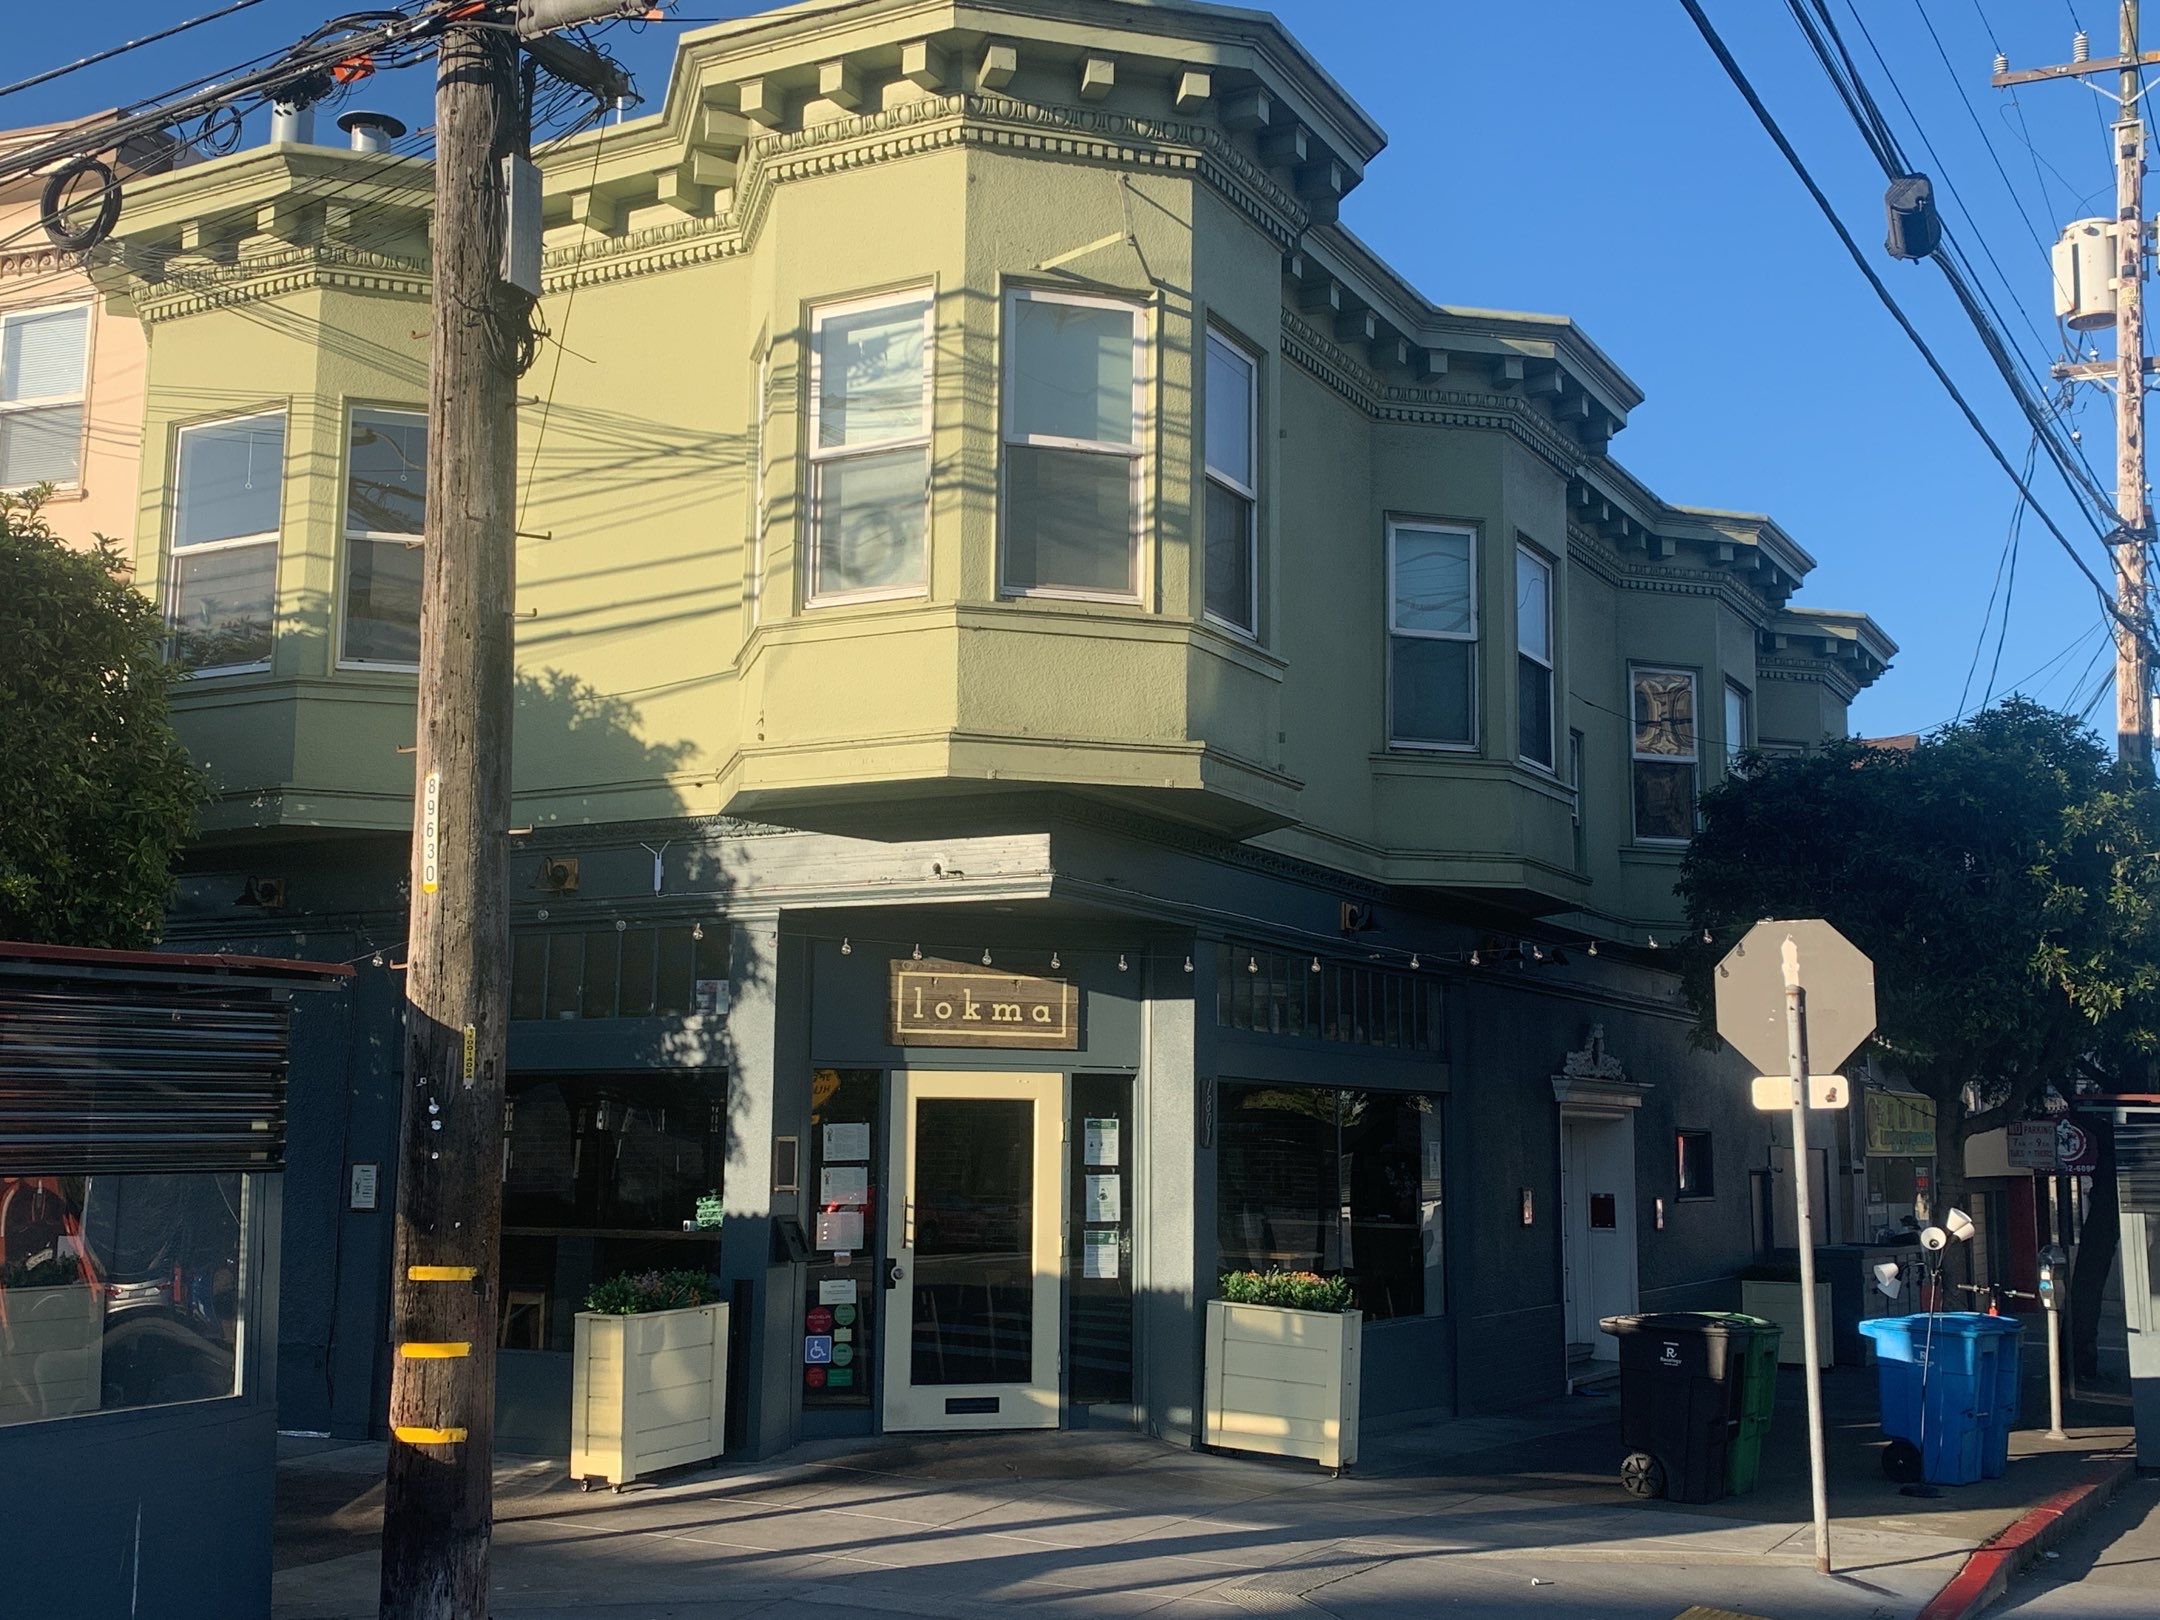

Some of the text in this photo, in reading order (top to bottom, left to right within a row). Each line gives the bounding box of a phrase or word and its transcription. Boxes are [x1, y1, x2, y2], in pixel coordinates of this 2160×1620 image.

[426, 778, 436, 882] 89630
[913, 986, 1052, 1023] lokma
[2024, 1124, 2054, 1135] PARKING
